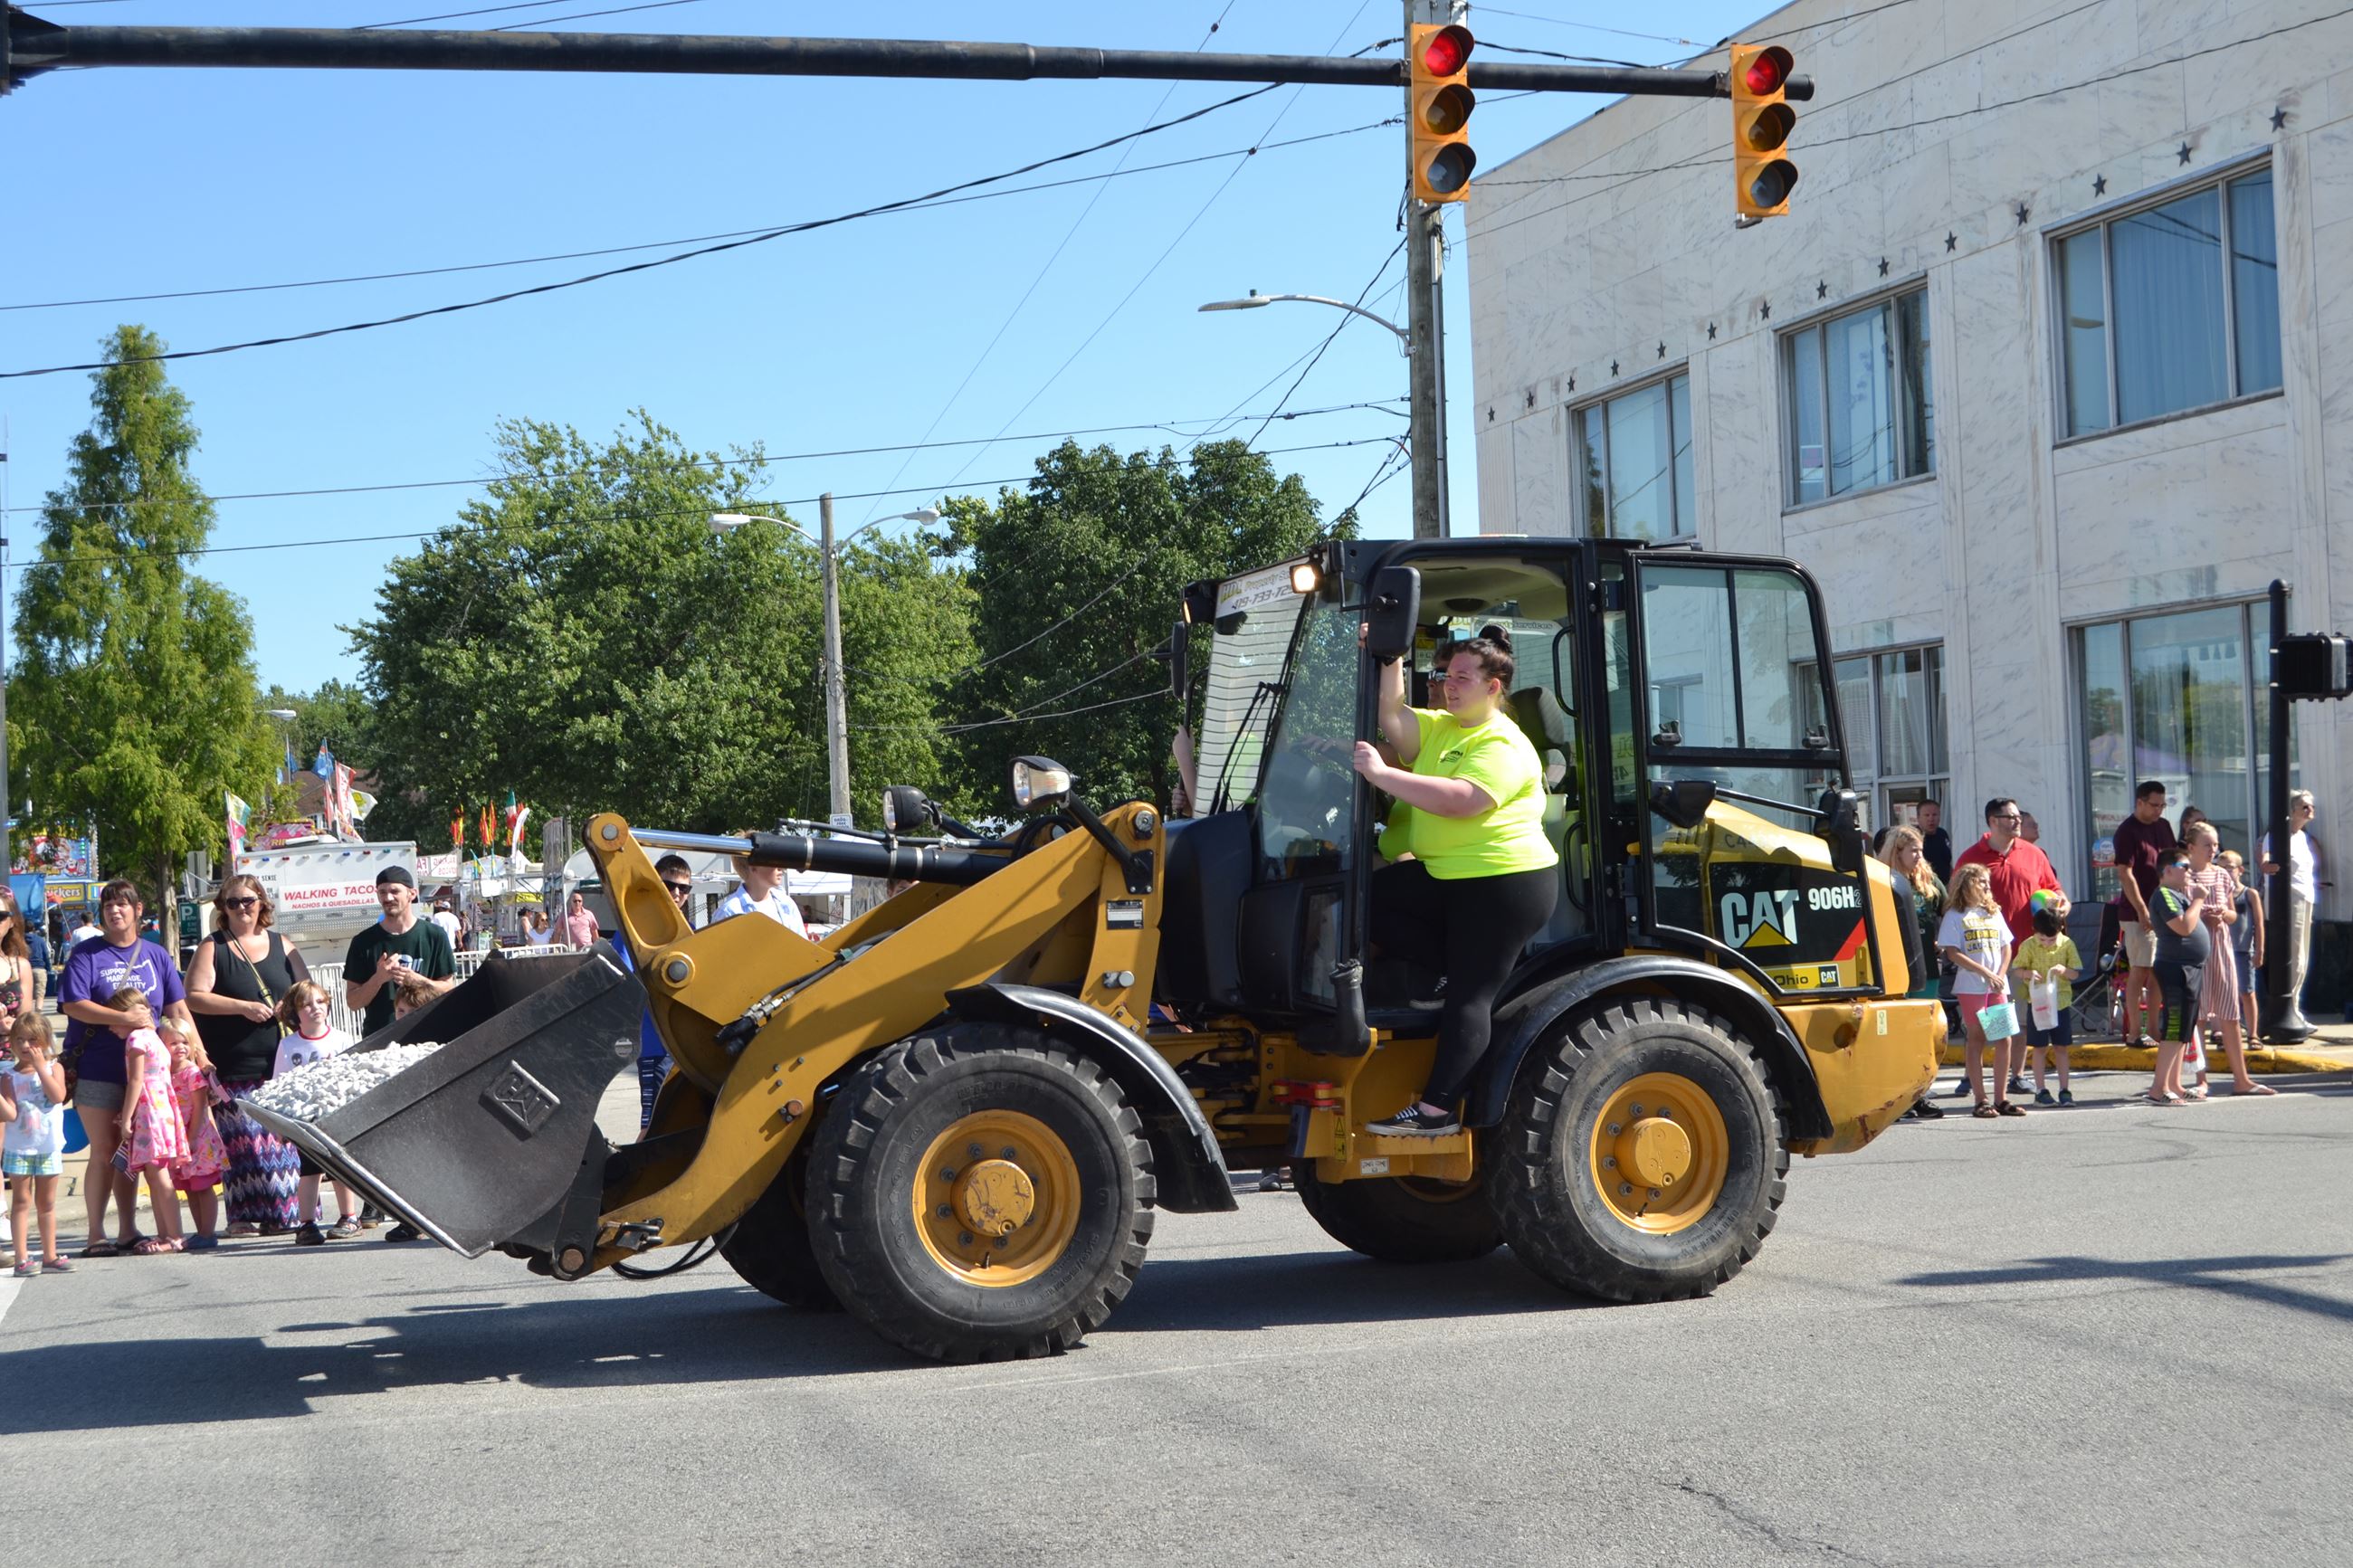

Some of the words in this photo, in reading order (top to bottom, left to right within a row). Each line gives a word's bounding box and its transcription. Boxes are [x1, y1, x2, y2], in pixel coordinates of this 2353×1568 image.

[284, 888, 338, 901] WALKING
[291, 900, 320, 909] NACHOS
[329, 898, 376, 907] QUESADILLAS
[181, 906, 193, 921] P
[1720, 889, 1799, 948] CAT
[100, 968, 127, 977] SUPPO
[106, 974, 142, 983] MARAGE
[1820, 971, 1837, 984] CAT
[1774, 974, 1809, 986] Ohio
[112, 982, 146, 991] EALITY
